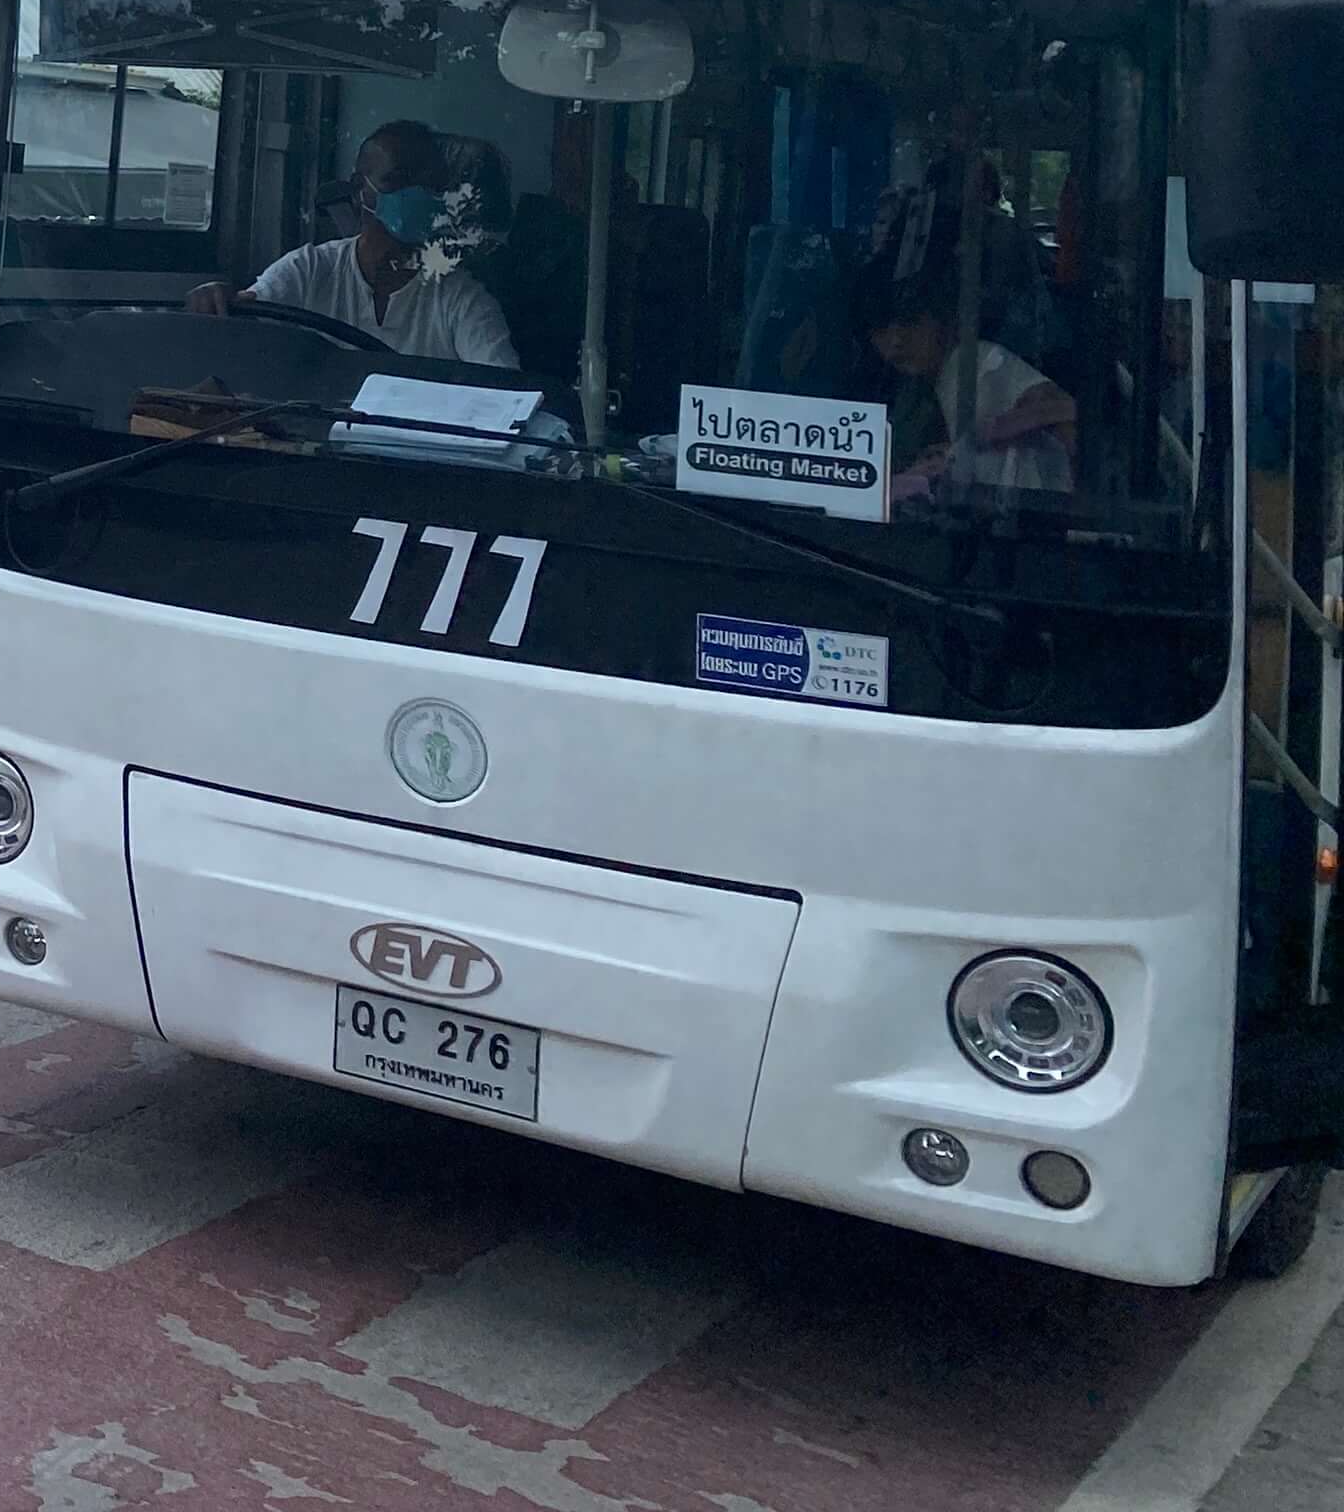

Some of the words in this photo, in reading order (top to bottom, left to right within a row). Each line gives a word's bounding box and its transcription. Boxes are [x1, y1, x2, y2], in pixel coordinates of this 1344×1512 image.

[692, 396, 874, 455] ไปตลาดน้ำ
[695, 447, 784, 476] Floating
[791, 457, 869, 483] Market
[349, 517, 548, 647] 777
[701, 628, 804, 657] ควบคุมการขับขี่
[845, 646, 878, 661] DTC
[701, 651, 758, 678] โดยระบบ
[762, 662, 803, 684] GPS
[831, 678, 879, 697] 1176
[369, 926, 485, 989] EVT
[351, 1000, 406, 1045] QC
[437, 1020, 511, 1071] 276
[365, 1053, 505, 1100] กรุงเทพมหานคร
